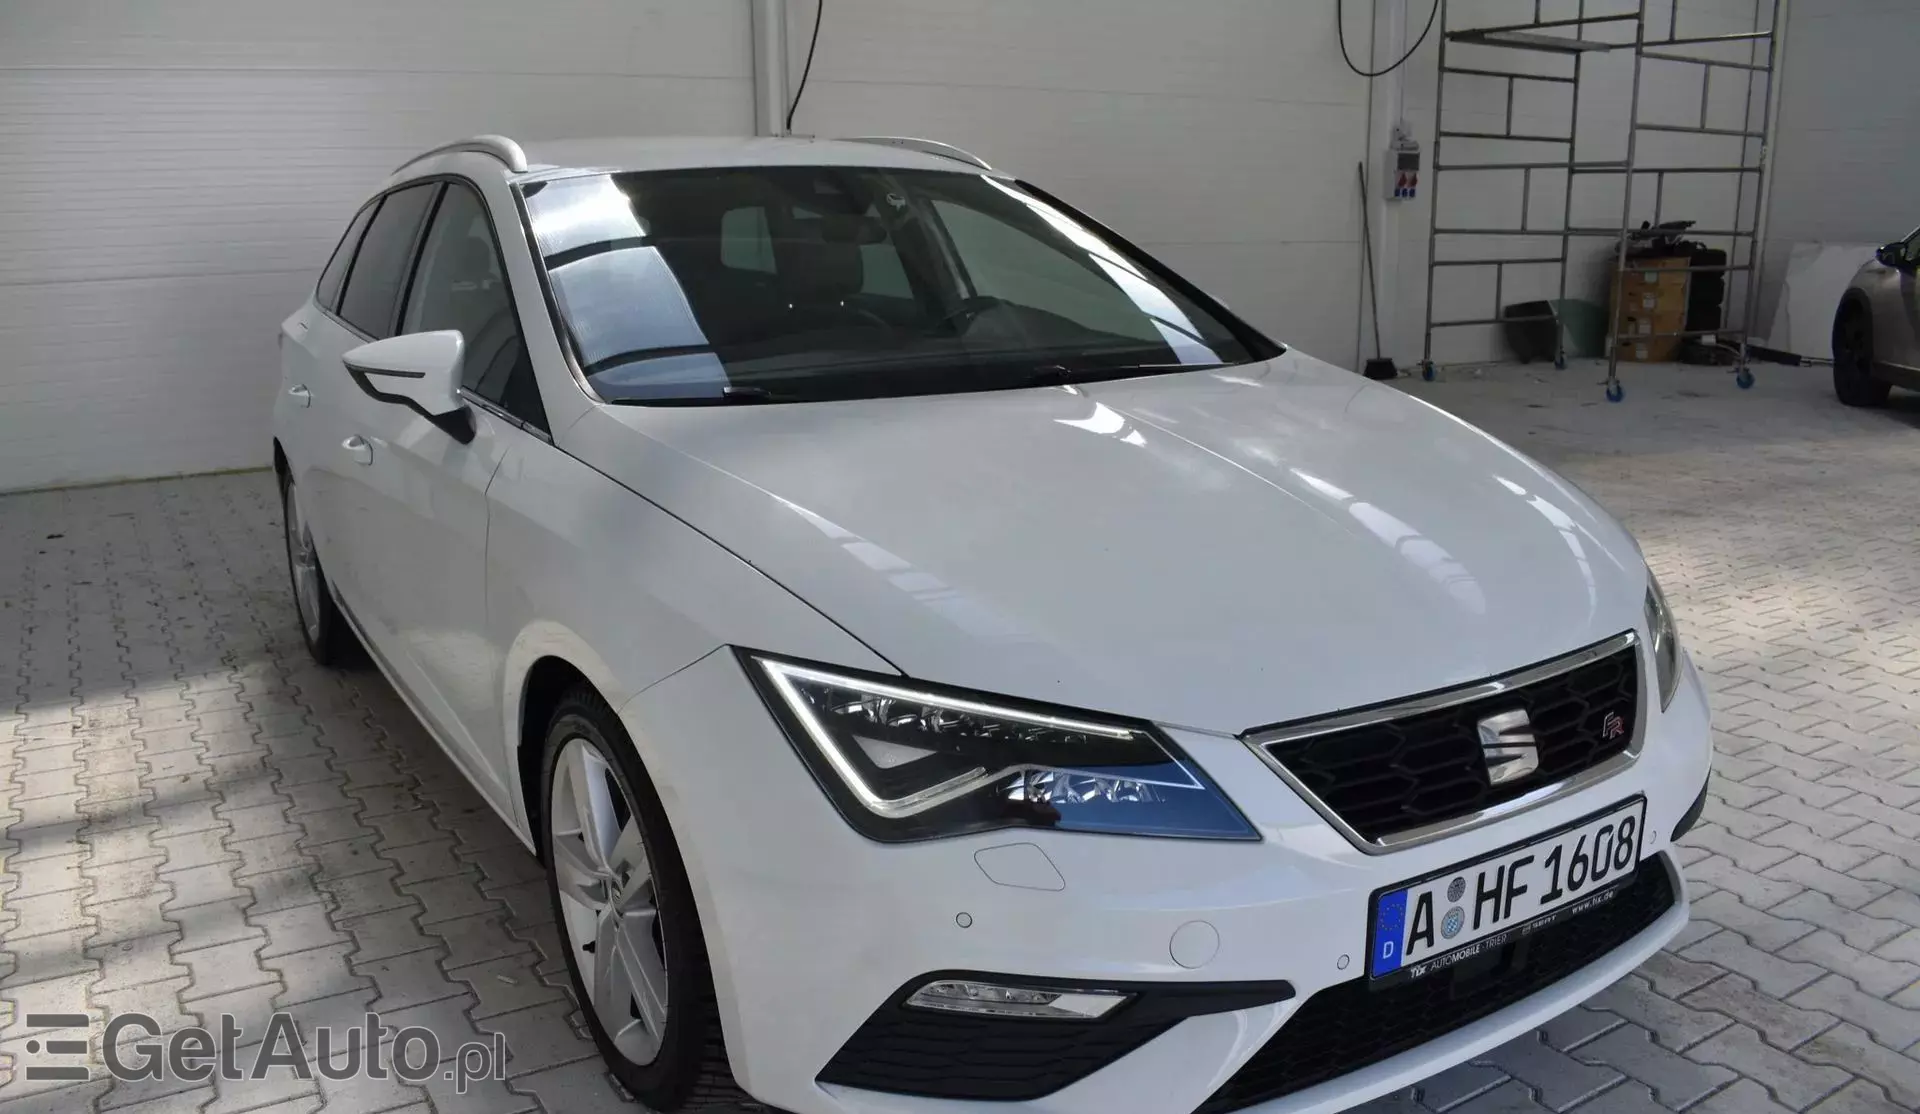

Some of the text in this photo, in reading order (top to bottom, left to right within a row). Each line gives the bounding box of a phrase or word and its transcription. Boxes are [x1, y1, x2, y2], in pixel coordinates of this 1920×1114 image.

[1602, 711, 1625, 739] FR
[1406, 891, 1434, 956] A
[1382, 941, 1395, 960] D
